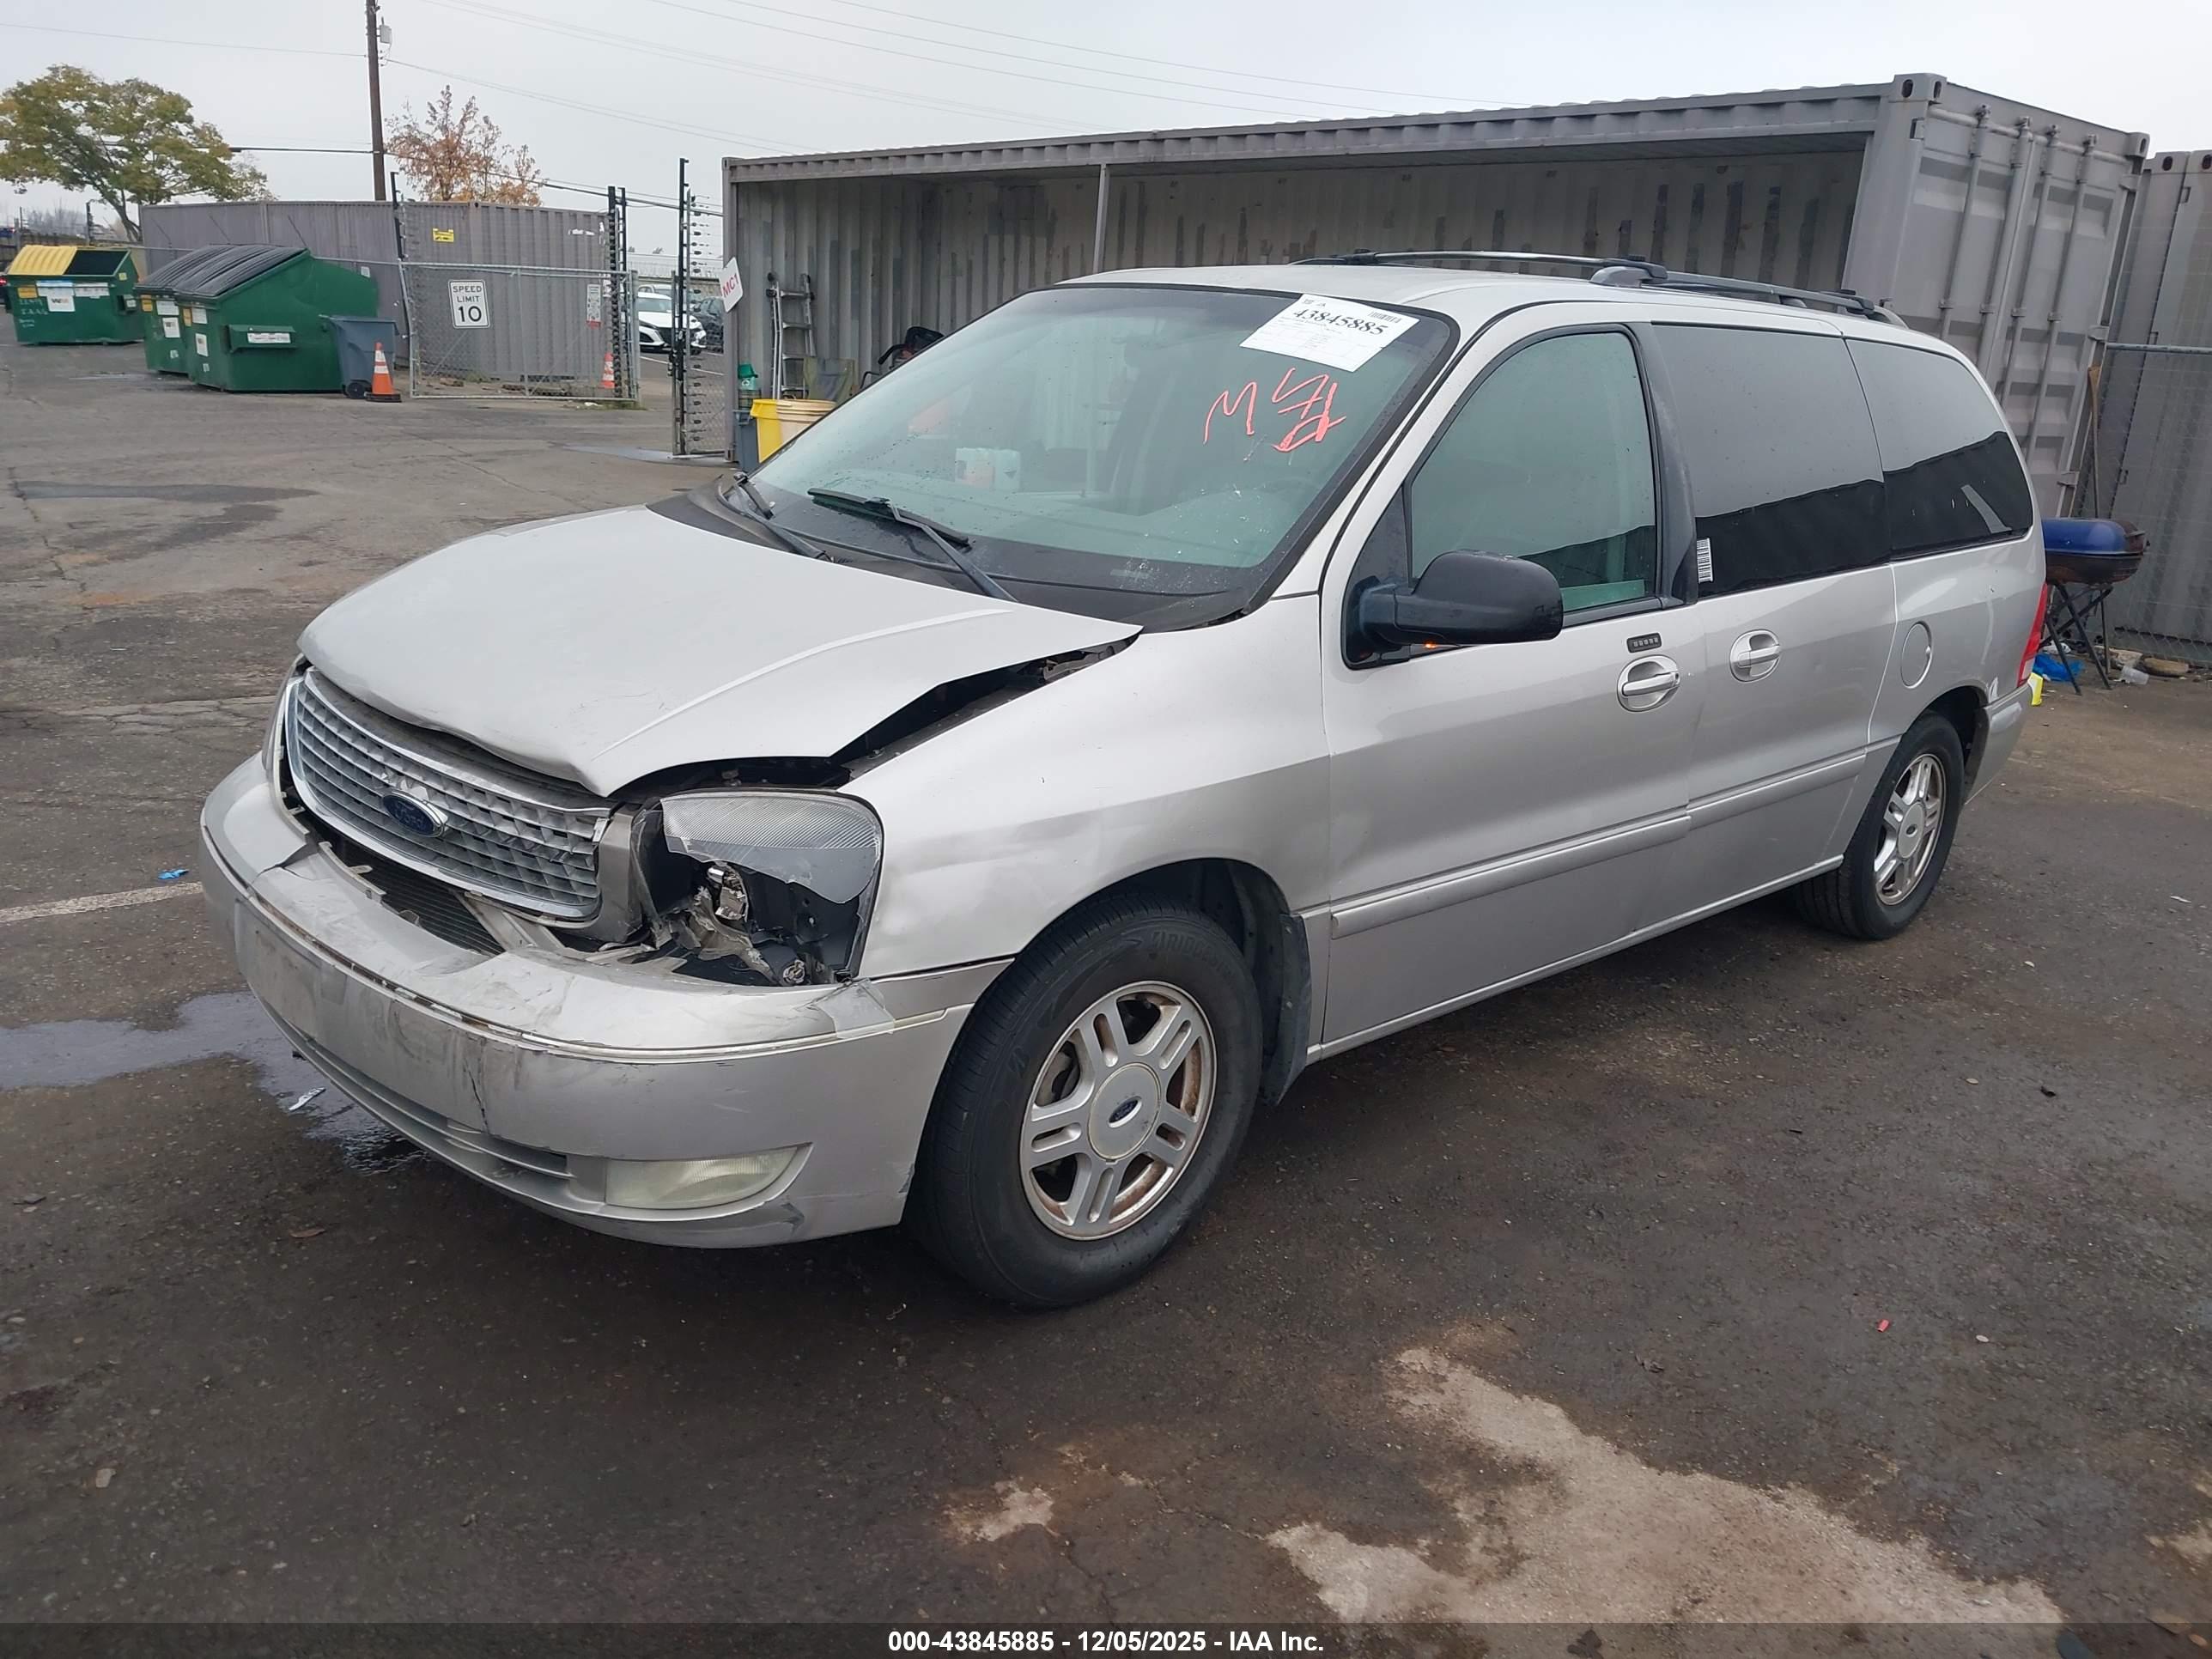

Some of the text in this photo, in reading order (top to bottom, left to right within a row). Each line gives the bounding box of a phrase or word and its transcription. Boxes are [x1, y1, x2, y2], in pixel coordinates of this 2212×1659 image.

[722, 273, 738, 299] MC1
[458, 306, 483, 323] 10
[1293, 308, 1389, 335] 43845885
